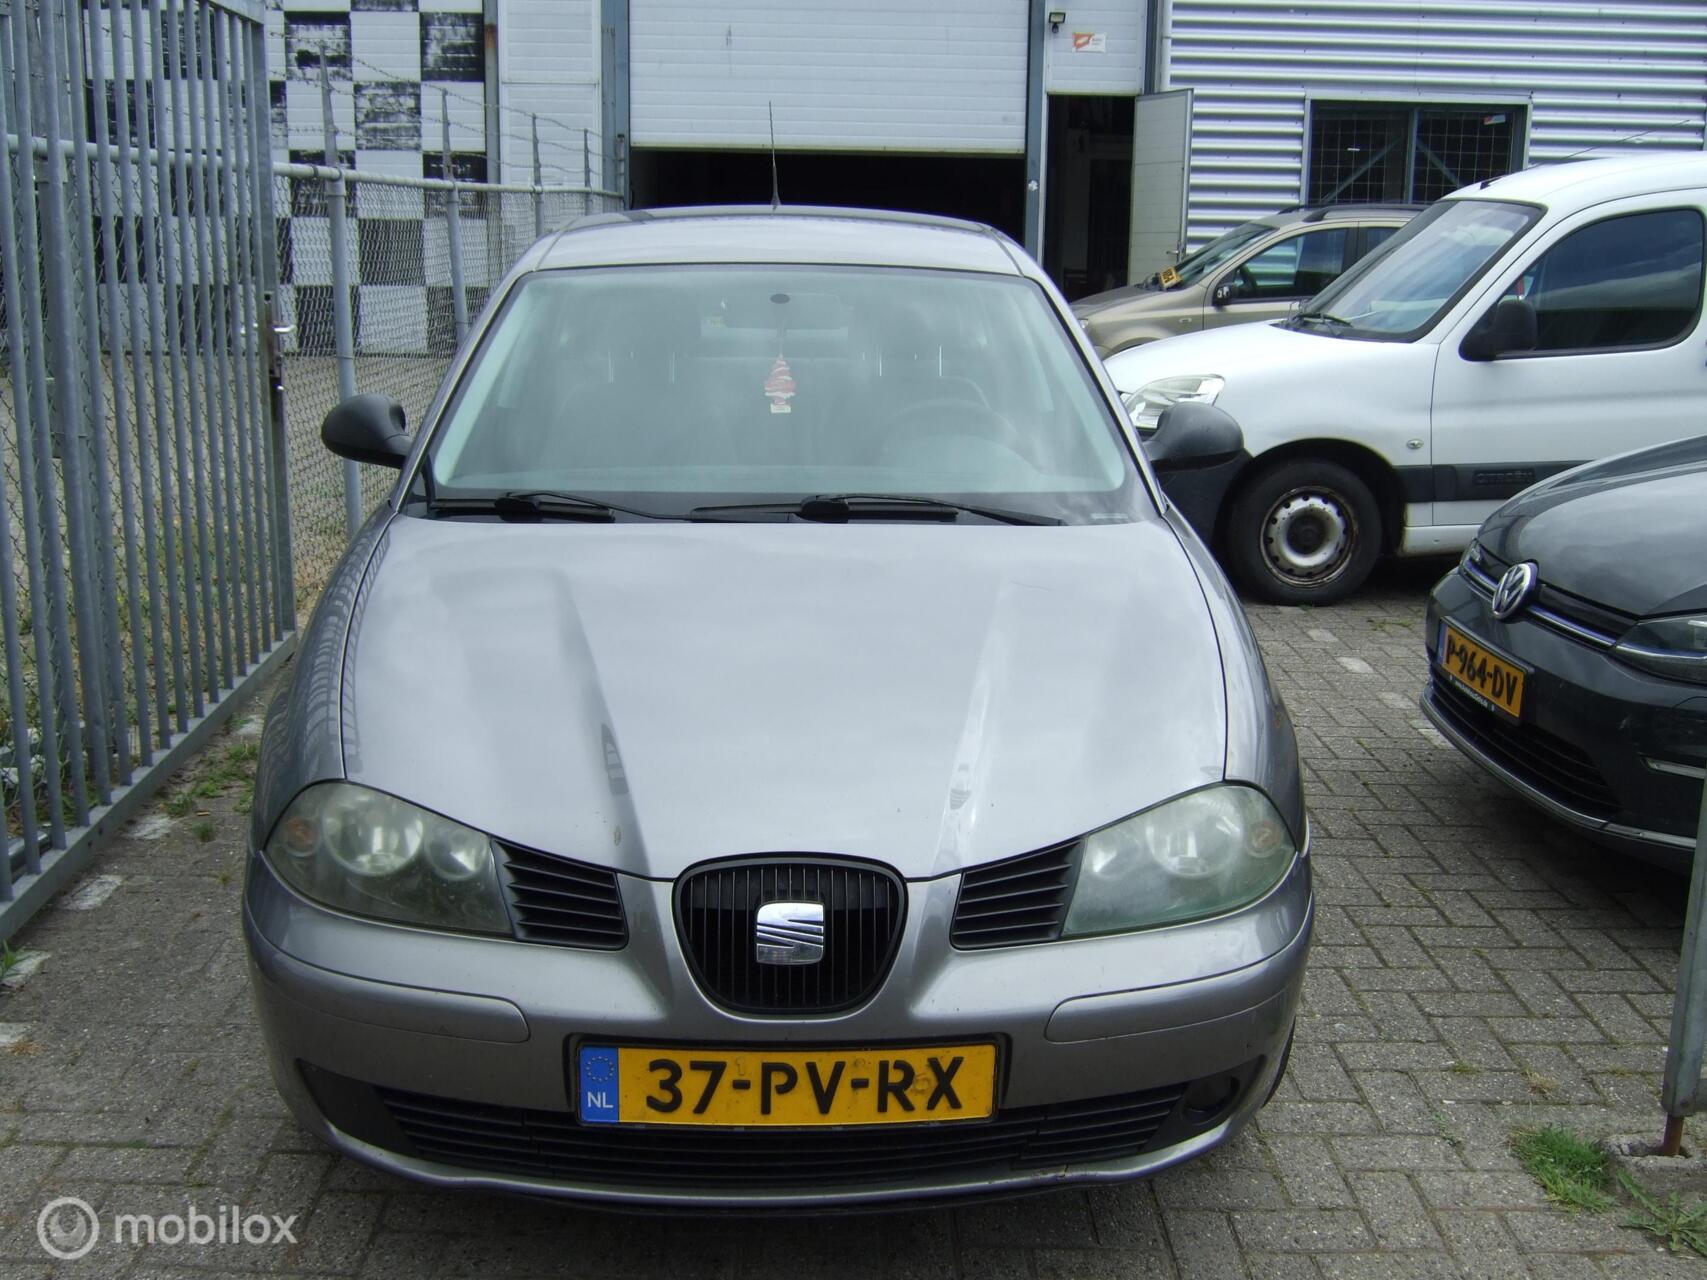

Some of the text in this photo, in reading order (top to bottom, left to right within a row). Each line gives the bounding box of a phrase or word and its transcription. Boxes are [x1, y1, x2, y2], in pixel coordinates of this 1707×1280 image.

[1446, 634, 1518, 707] P-964-DV
[587, 1091, 613, 1109] NL
[646, 1057, 964, 1115] 37-PV-RX
